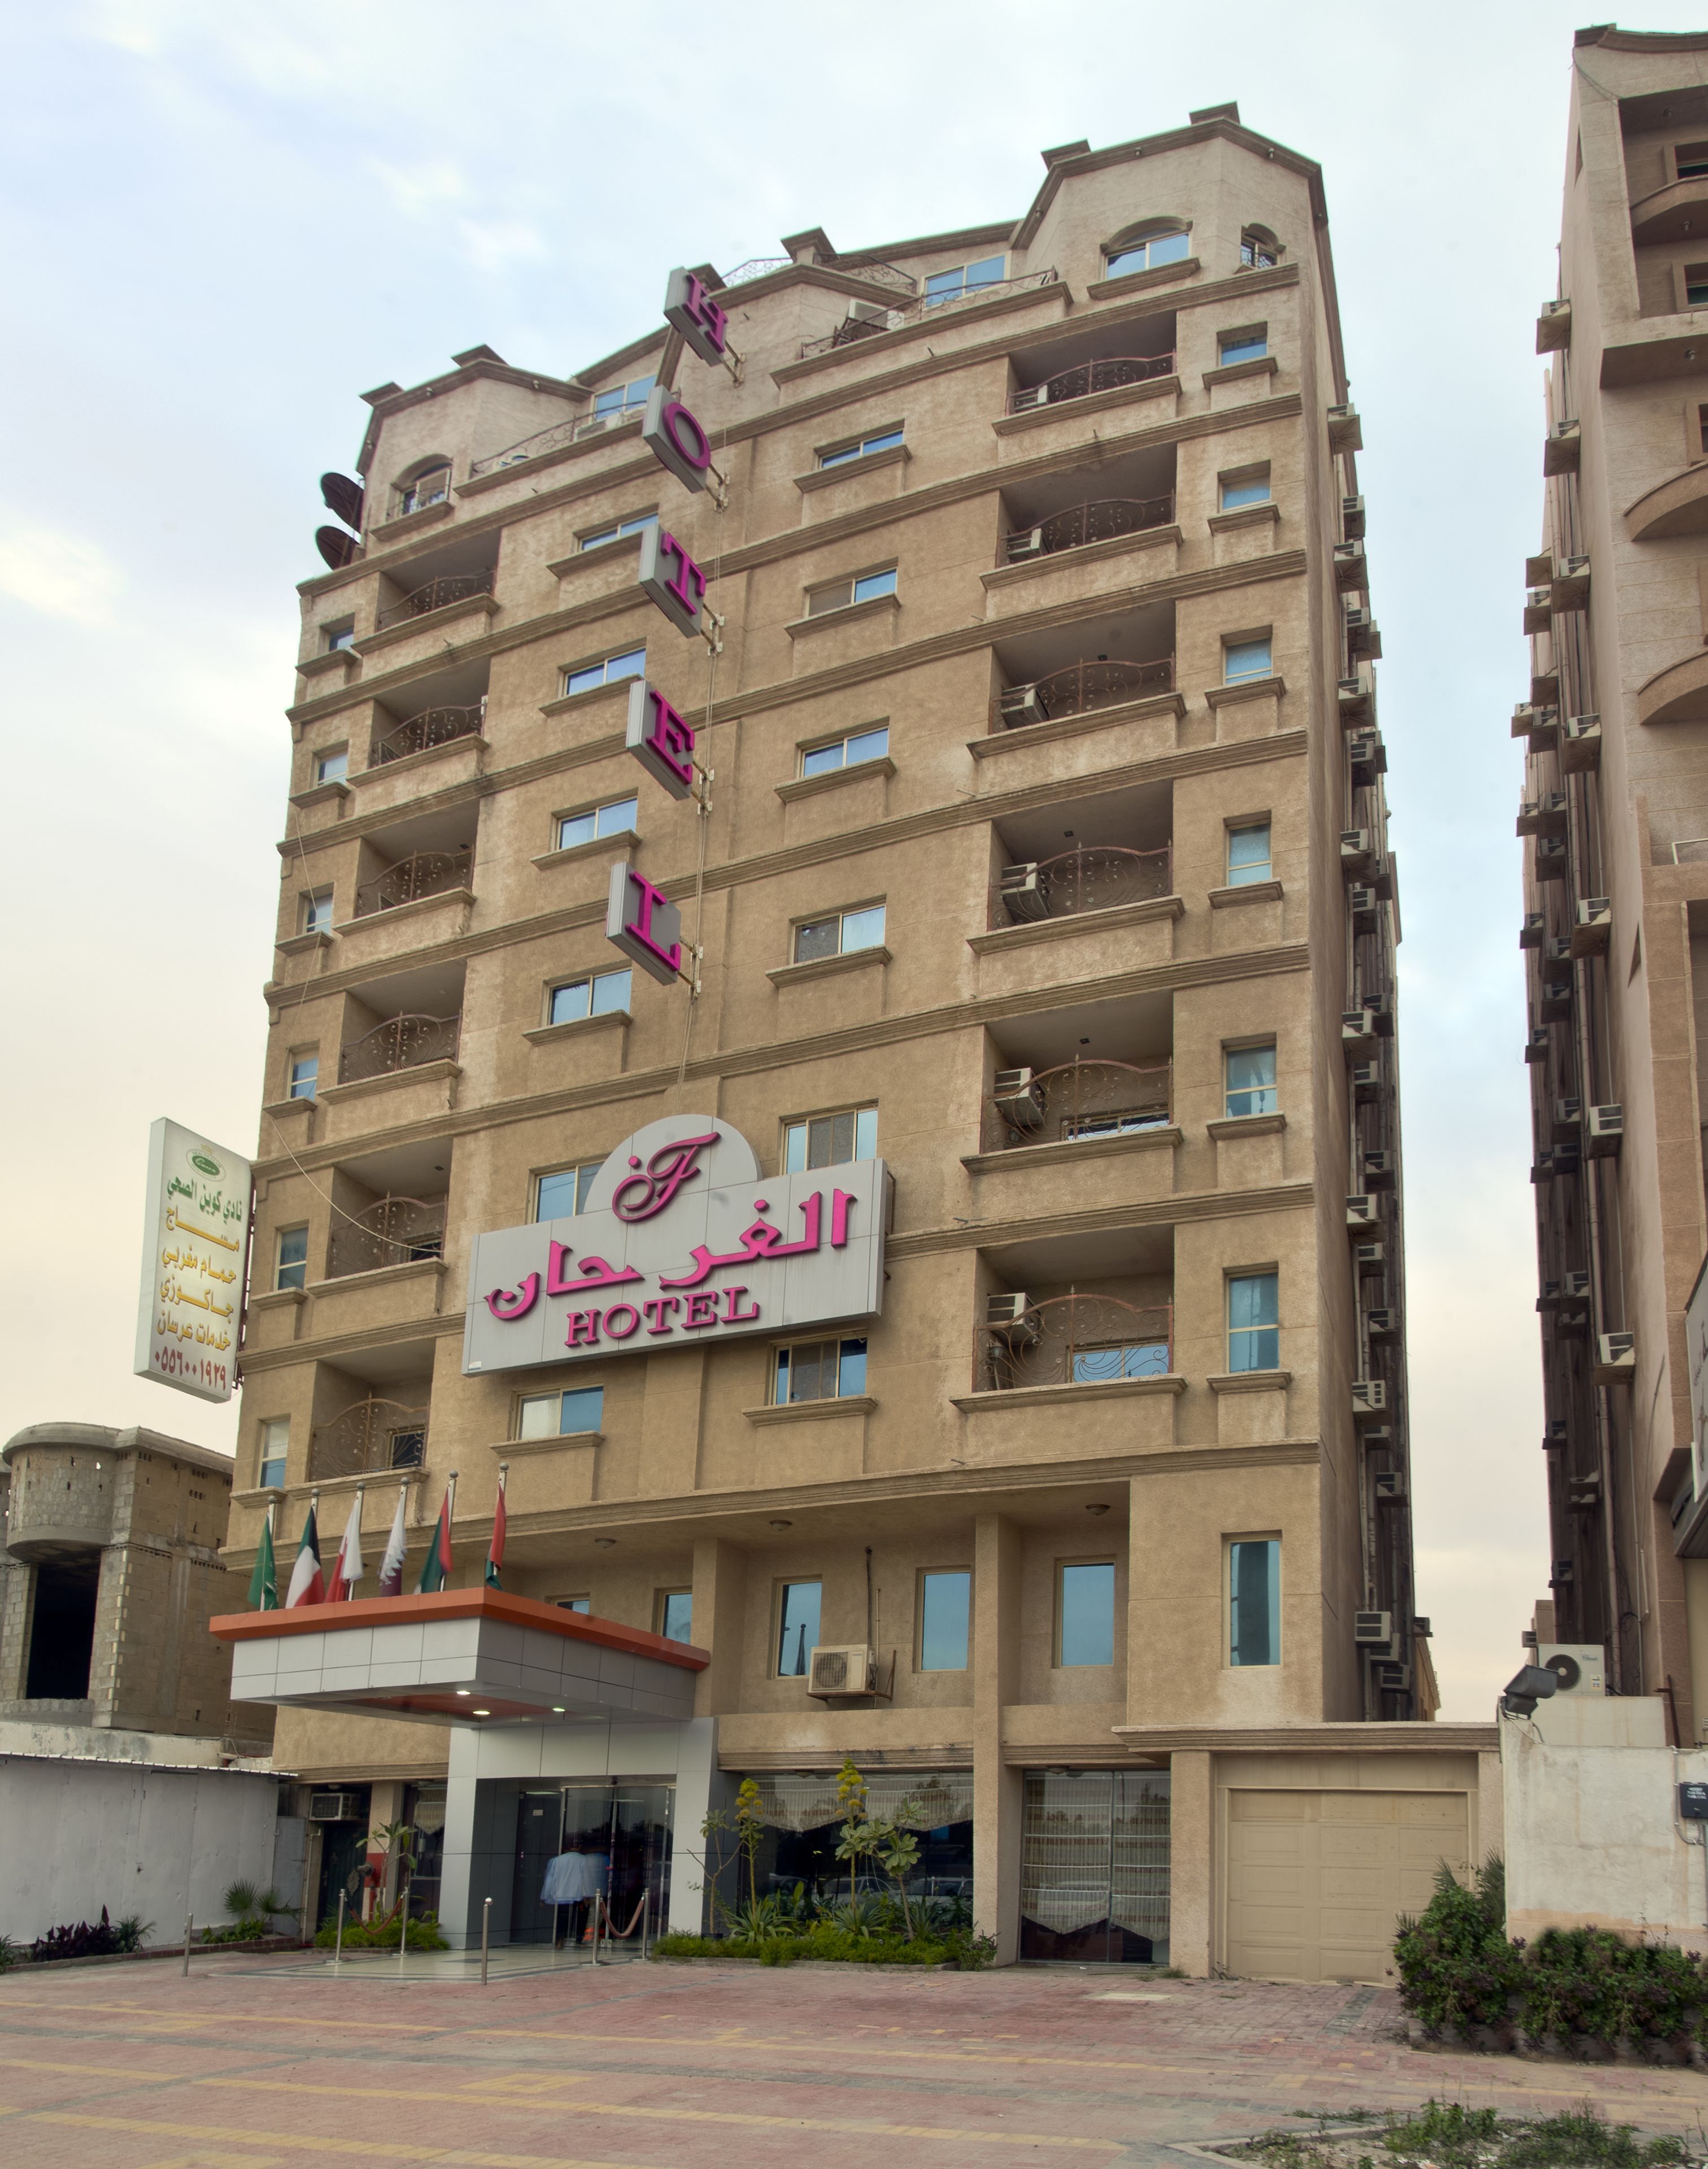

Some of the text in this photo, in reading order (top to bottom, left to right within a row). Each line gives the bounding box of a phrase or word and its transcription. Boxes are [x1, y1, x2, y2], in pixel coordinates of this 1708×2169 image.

[167, 1176, 198, 1201] الصحي
[223, 1199, 242, 1225] نادي
[161, 1243, 237, 1284] حمام مغربي
[483, 1187, 858, 1321] الفرحان
[160, 1273, 234, 1324] جاكوزي
[565, 1286, 760, 1347] HOTEL
[156, 1309, 231, 1351] خدمات عرسان
[154, 1345, 226, 1391] ٠٥٥٦٠٠١٩٢٩
